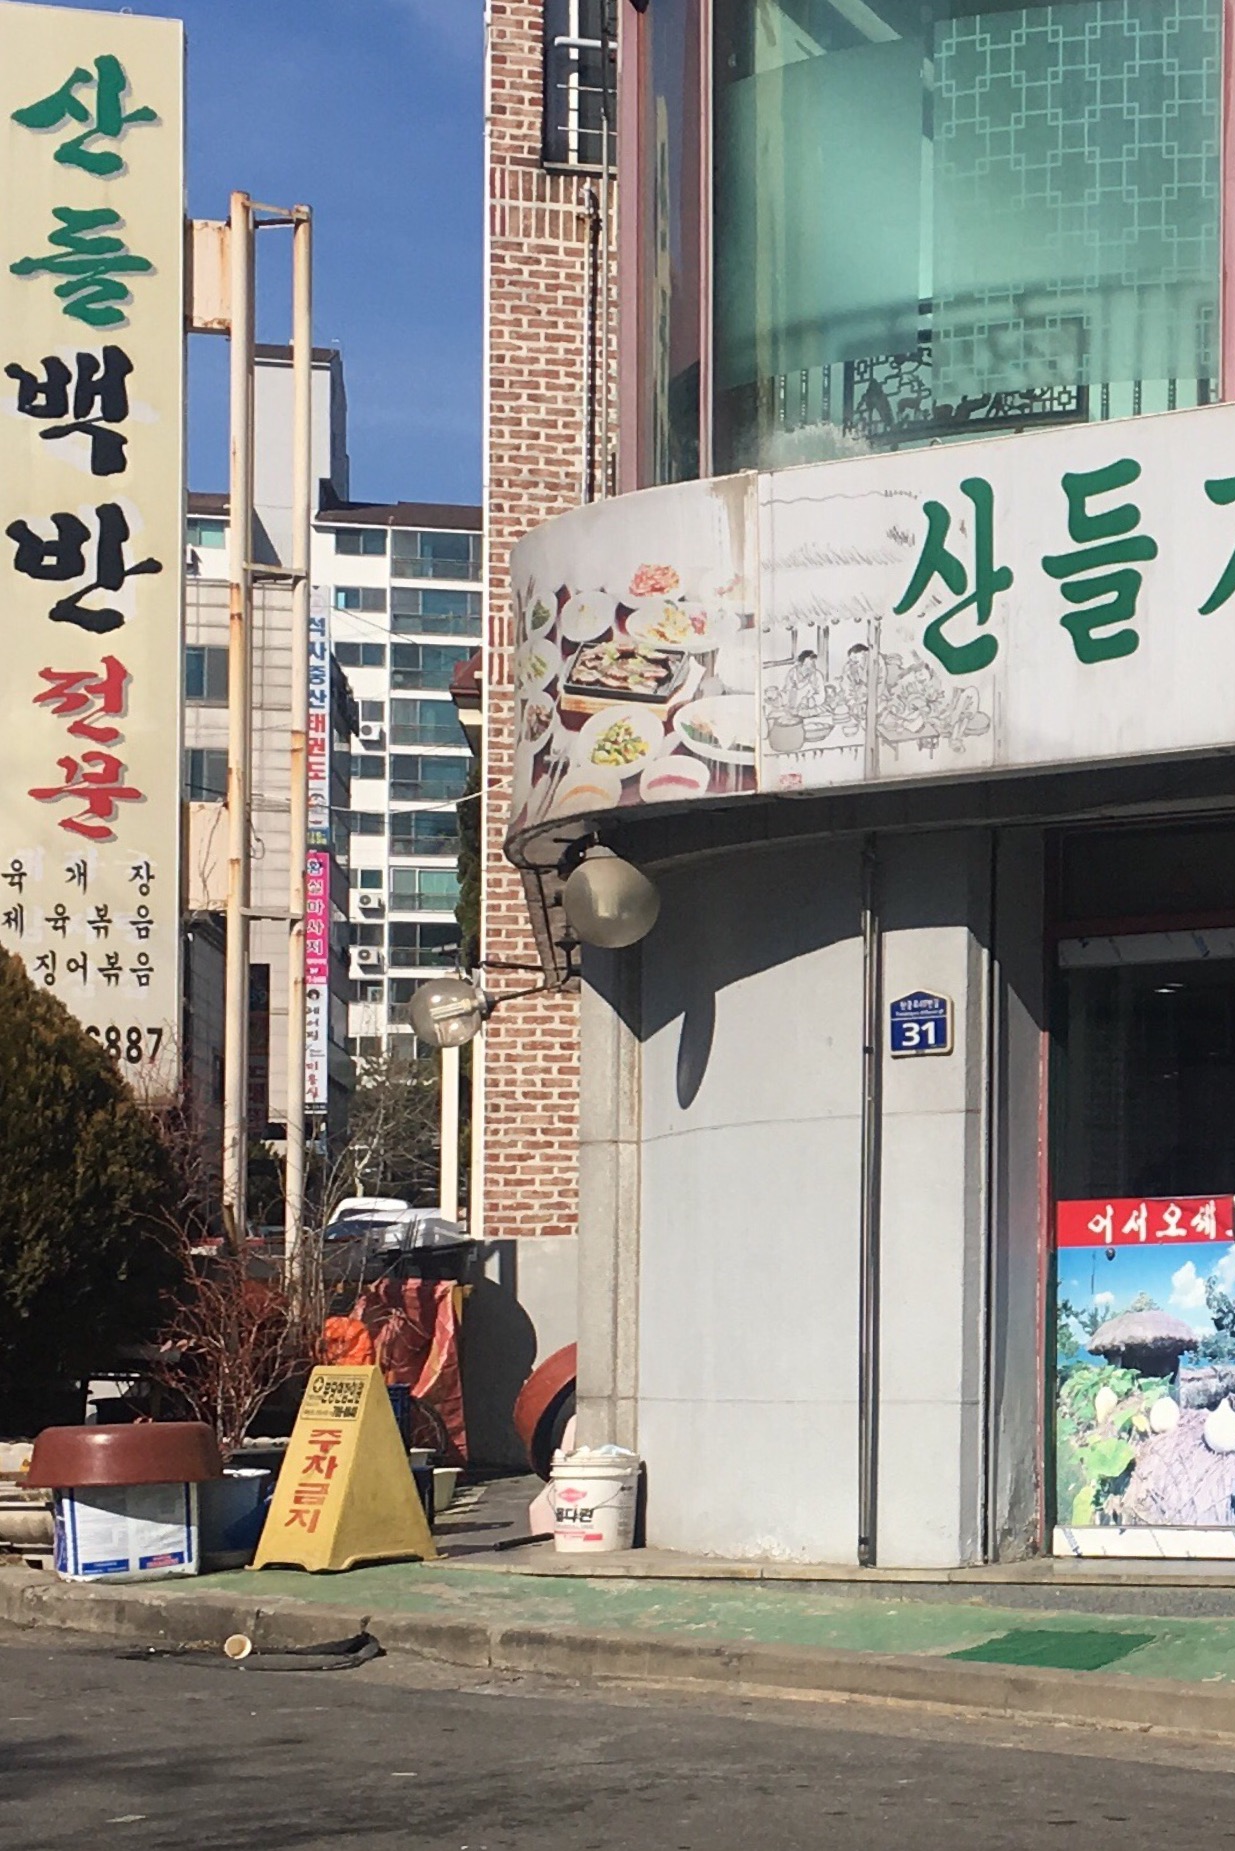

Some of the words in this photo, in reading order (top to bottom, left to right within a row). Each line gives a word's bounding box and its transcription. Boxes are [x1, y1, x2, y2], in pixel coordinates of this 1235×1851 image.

[11, 54, 157, 326] 산들
[4, 345, 162, 634] 백반
[28, 655, 141, 838] 전문
[1, 859, 155, 896] 육개장
[2, 903, 154, 939] 제육볶음
[33, 950, 154, 986] 징어볶음
[902, 1021, 936, 1047] 31
[284, 1429, 343, 1533] 주차금지
